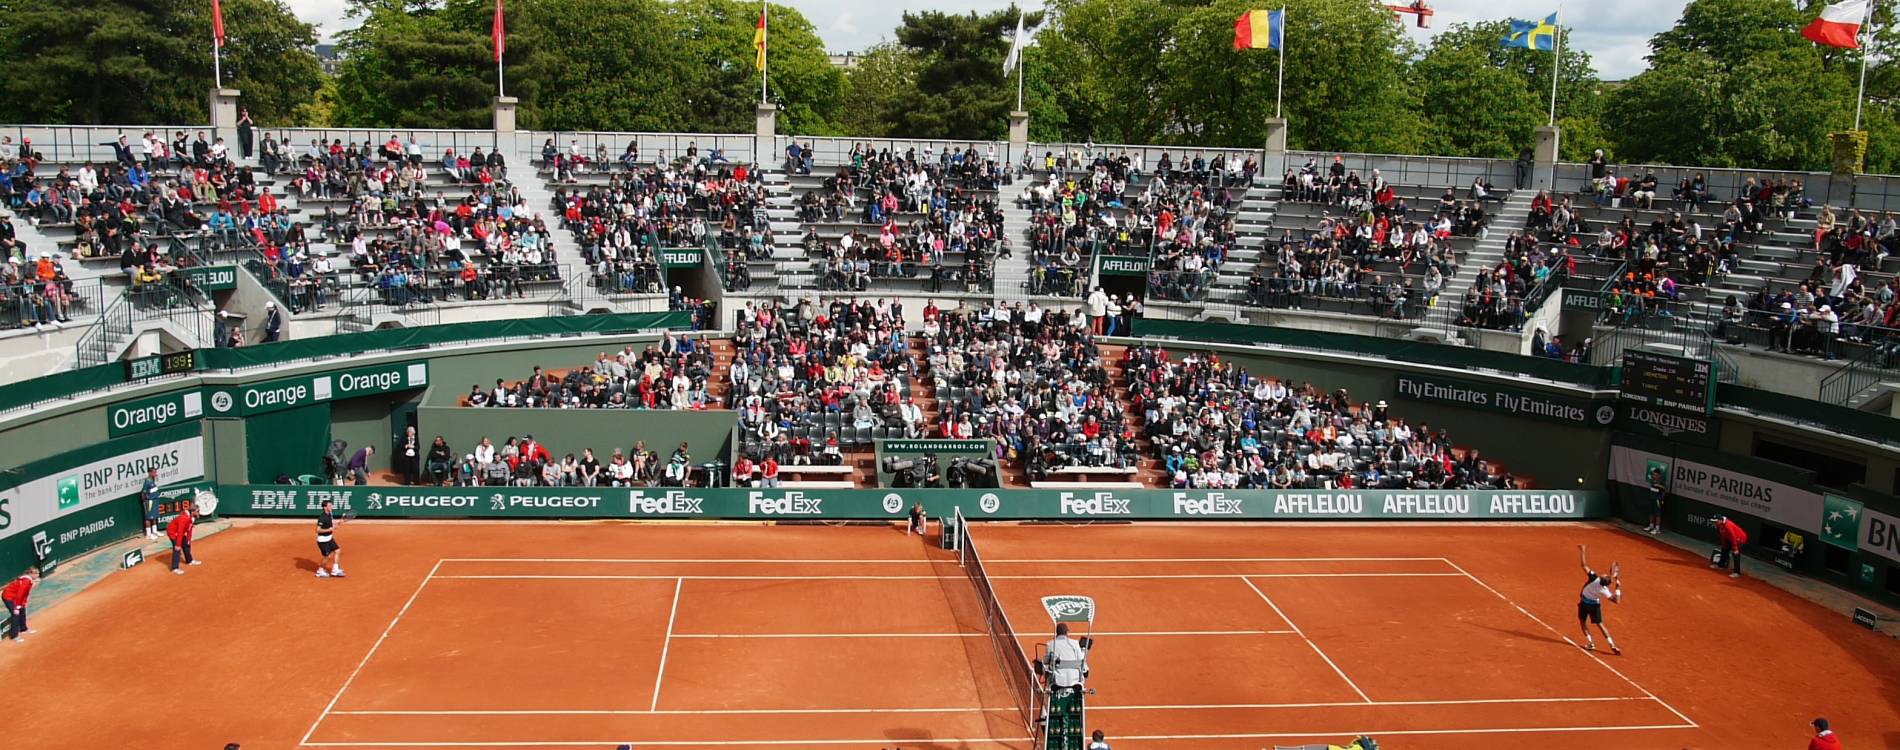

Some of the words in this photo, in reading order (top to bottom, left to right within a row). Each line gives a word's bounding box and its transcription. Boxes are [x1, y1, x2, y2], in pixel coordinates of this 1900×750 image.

[663, 253, 702, 264] FFLELOU
[1103, 260, 1148, 272] AFFLELOU
[191, 271, 234, 286] FFLELOU
[1565, 294, 1599, 308] AFFLEL
[131, 358, 160, 379] IBM
[339, 371, 400, 392] Orange
[1399, 378, 1422, 398] Fly
[1424, 382, 1487, 405] Emirates
[245, 384, 307, 408] Orange
[1495, 391, 1518, 413] Fly
[1521, 396, 1585, 422] Emirates
[114, 402, 176, 428] Orange
[1629, 407, 1706, 434] LONGINES
[83, 466, 113, 490] BNP
[117, 450, 179, 480] PARIBAS
[1676, 466, 1707, 485] BNP
[1710, 474, 1773, 503] PARIBAS
[84, 491, 96, 500] The
[251, 490, 296, 510] IBM
[306, 491, 352, 510] IBM
[385, 495, 479, 507] PEUGEOT
[509, 496, 601, 507] PEUGEOT
[629, 490, 703, 514] FedEx
[749, 491, 822, 514] FedEx
[1060, 492, 1131, 515] FedEx
[1173, 492, 1242, 515] FedEx
[1273, 493, 1363, 515] AFFLELOU
[1383, 493, 1469, 514] AFFLELOU
[1489, 493, 1575, 514] AFFLELOU
[60, 529, 78, 545] BNP
[79, 516, 115, 537] PARIBAS
